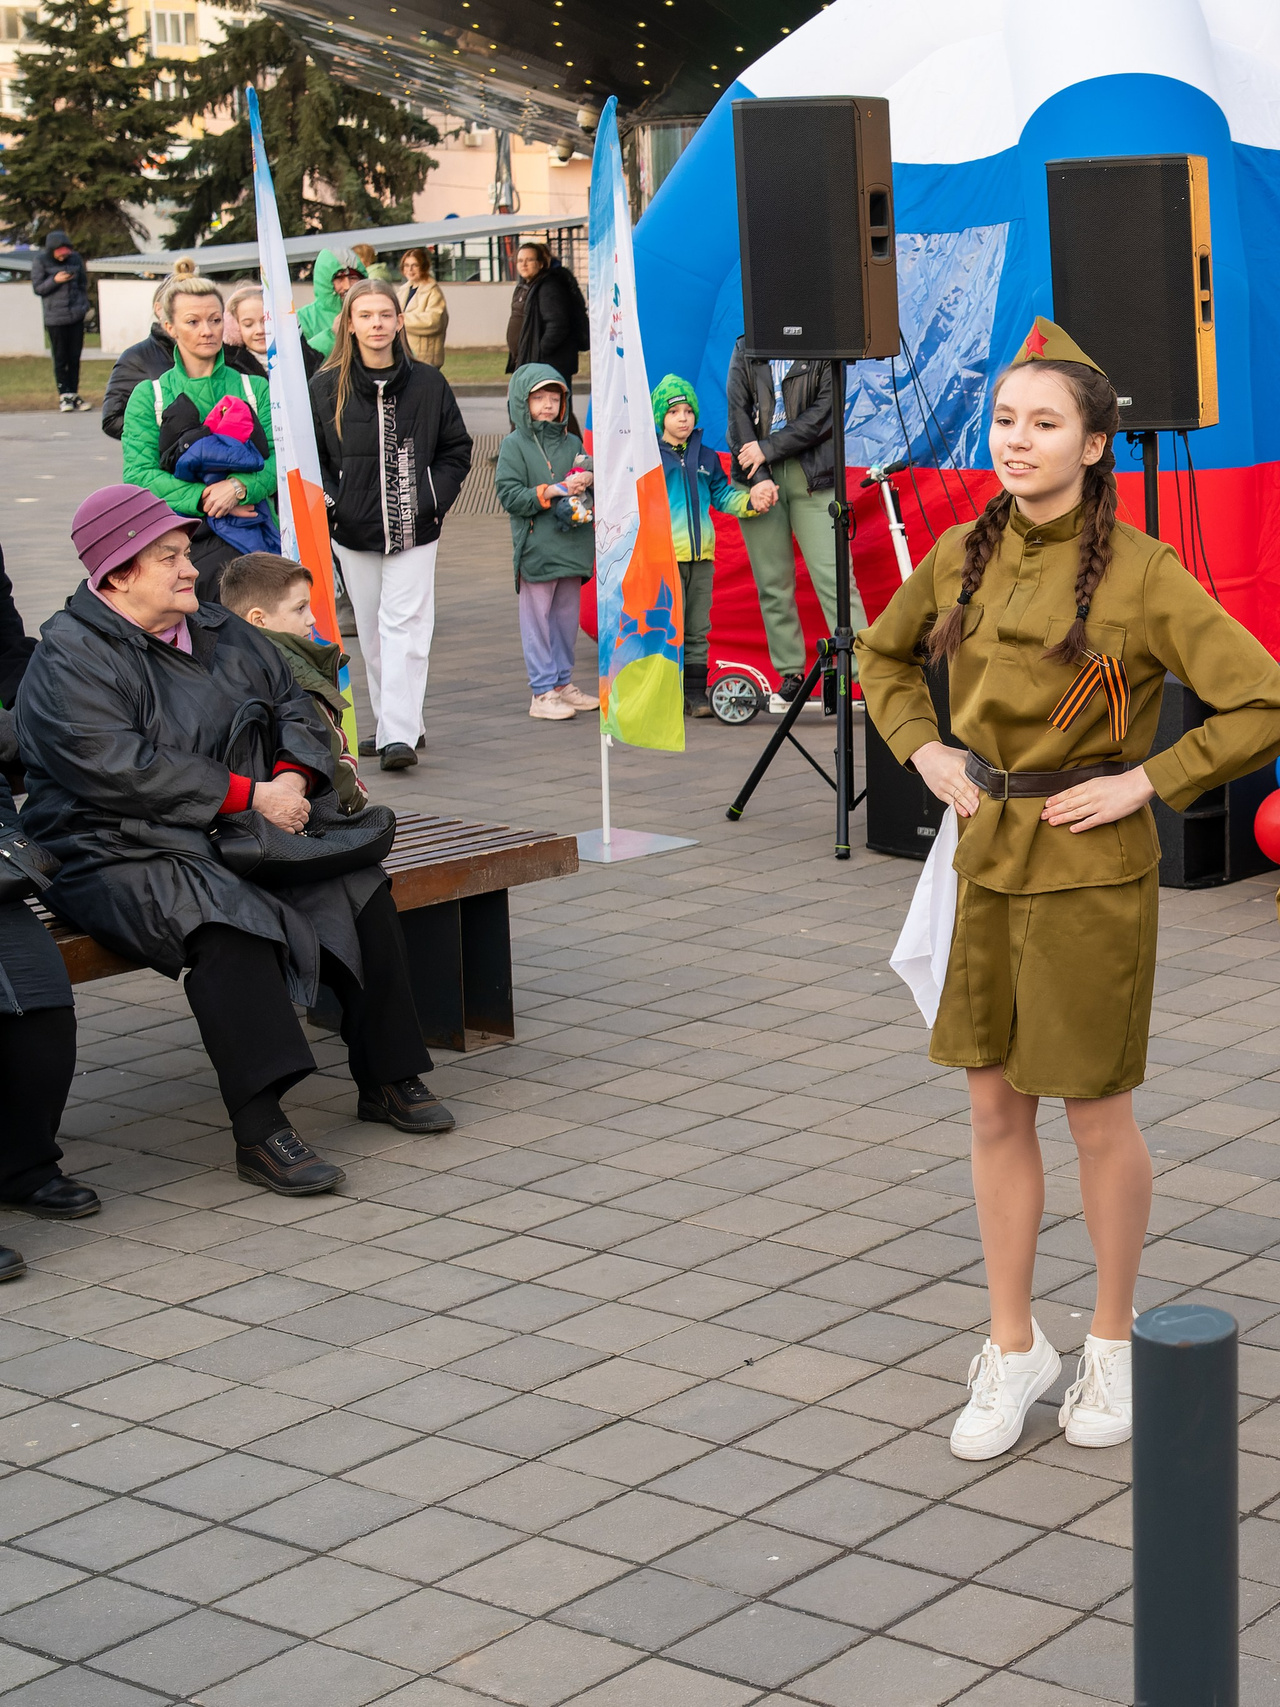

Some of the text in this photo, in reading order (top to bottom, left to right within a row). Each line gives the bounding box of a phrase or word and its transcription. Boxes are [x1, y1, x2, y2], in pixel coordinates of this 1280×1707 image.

[397, 447, 412, 524] LOST IN THE MIDDLE
